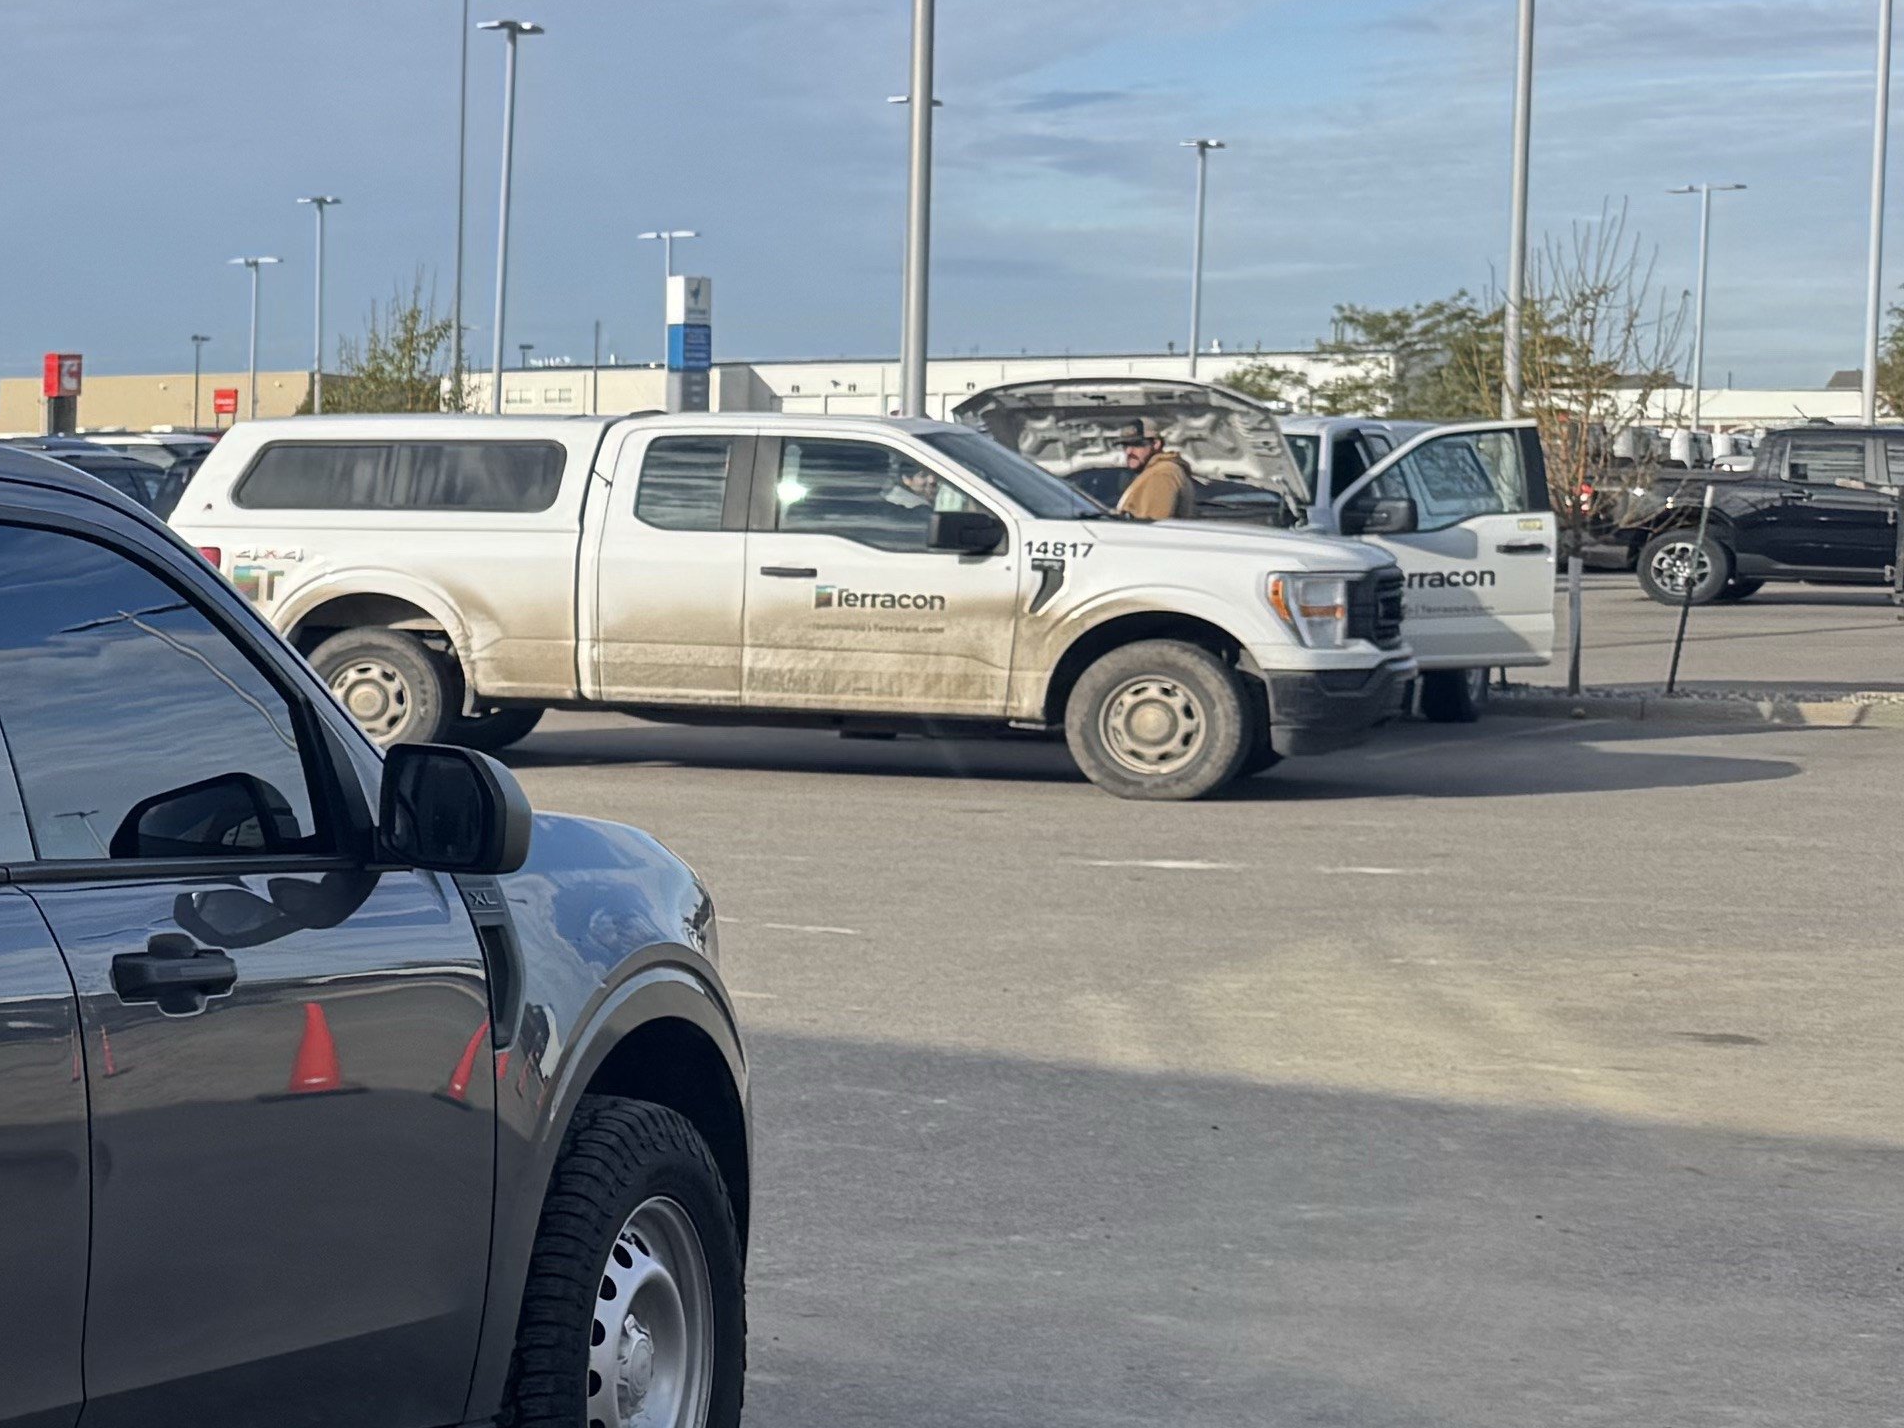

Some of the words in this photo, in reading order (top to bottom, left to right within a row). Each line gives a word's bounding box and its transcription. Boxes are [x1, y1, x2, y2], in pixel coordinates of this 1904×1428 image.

[1024, 540, 1094, 558] 14817
[1402, 570, 1496, 588] rracon
[837, 588, 945, 610] Terracon
[468, 891, 498, 906] XL
